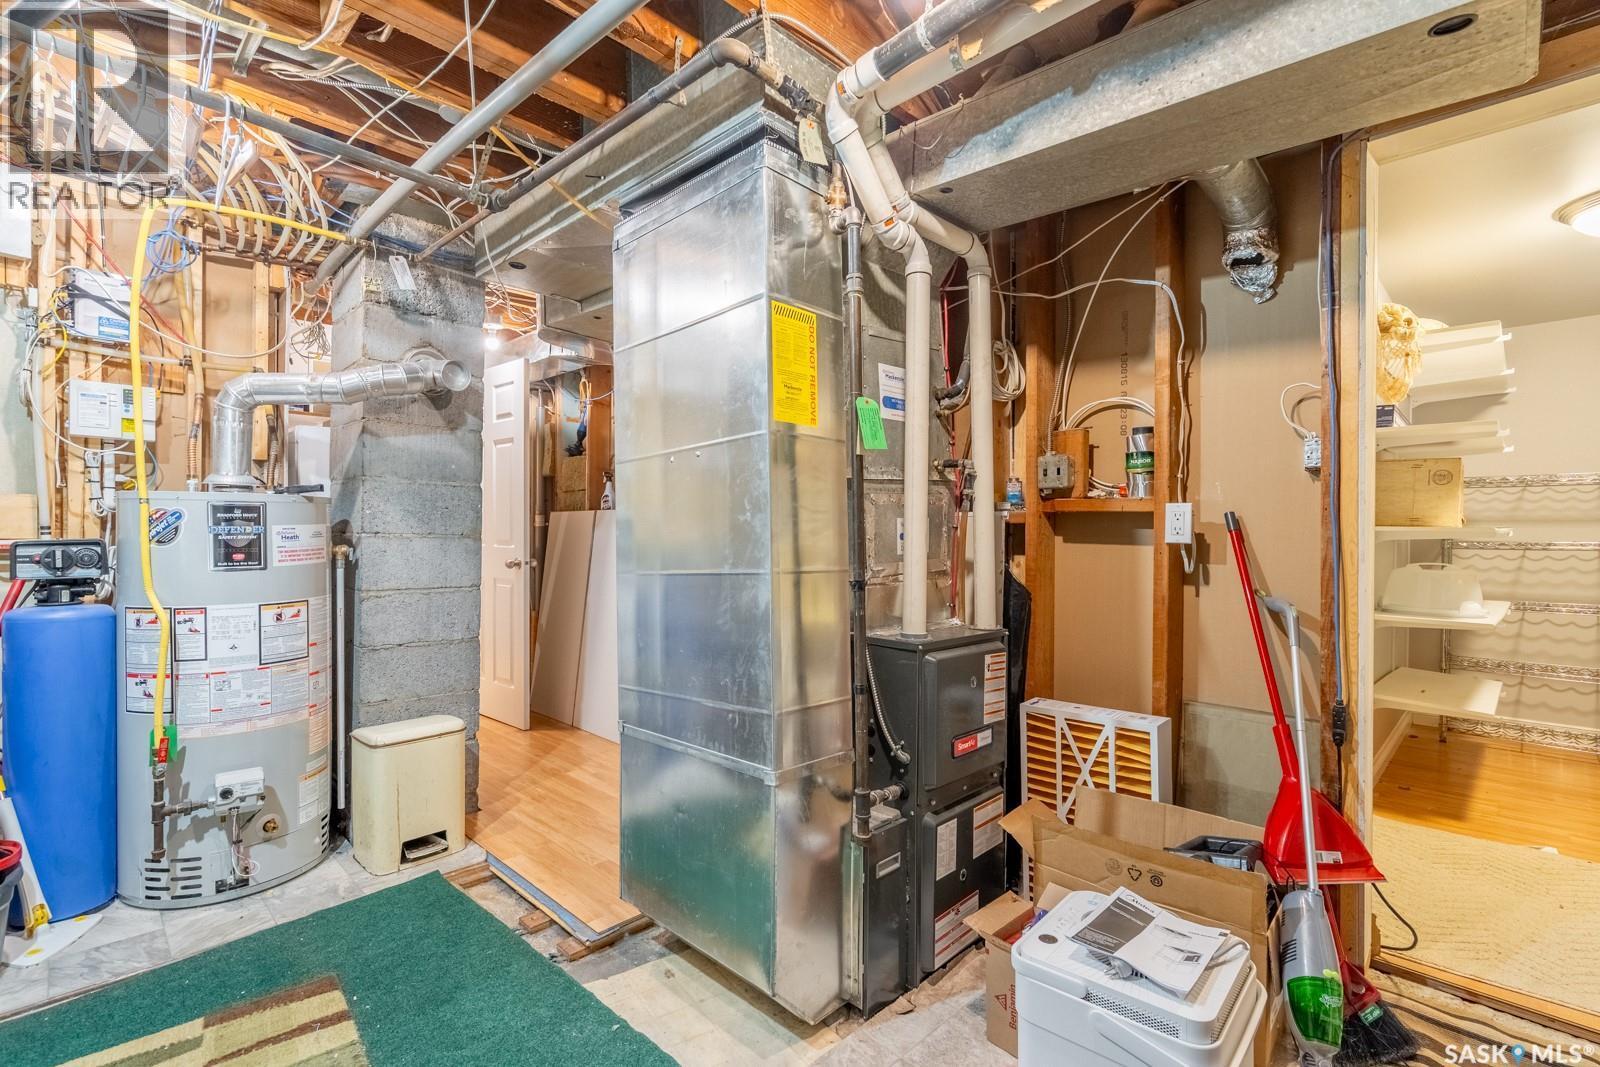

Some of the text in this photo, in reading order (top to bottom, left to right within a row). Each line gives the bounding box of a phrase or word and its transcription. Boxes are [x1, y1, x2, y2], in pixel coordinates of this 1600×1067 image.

[808, 326, 815, 343] DO
[208, 526, 265, 534] DEFENDER
[1008, 984, 1017, 1030] Benjamin
